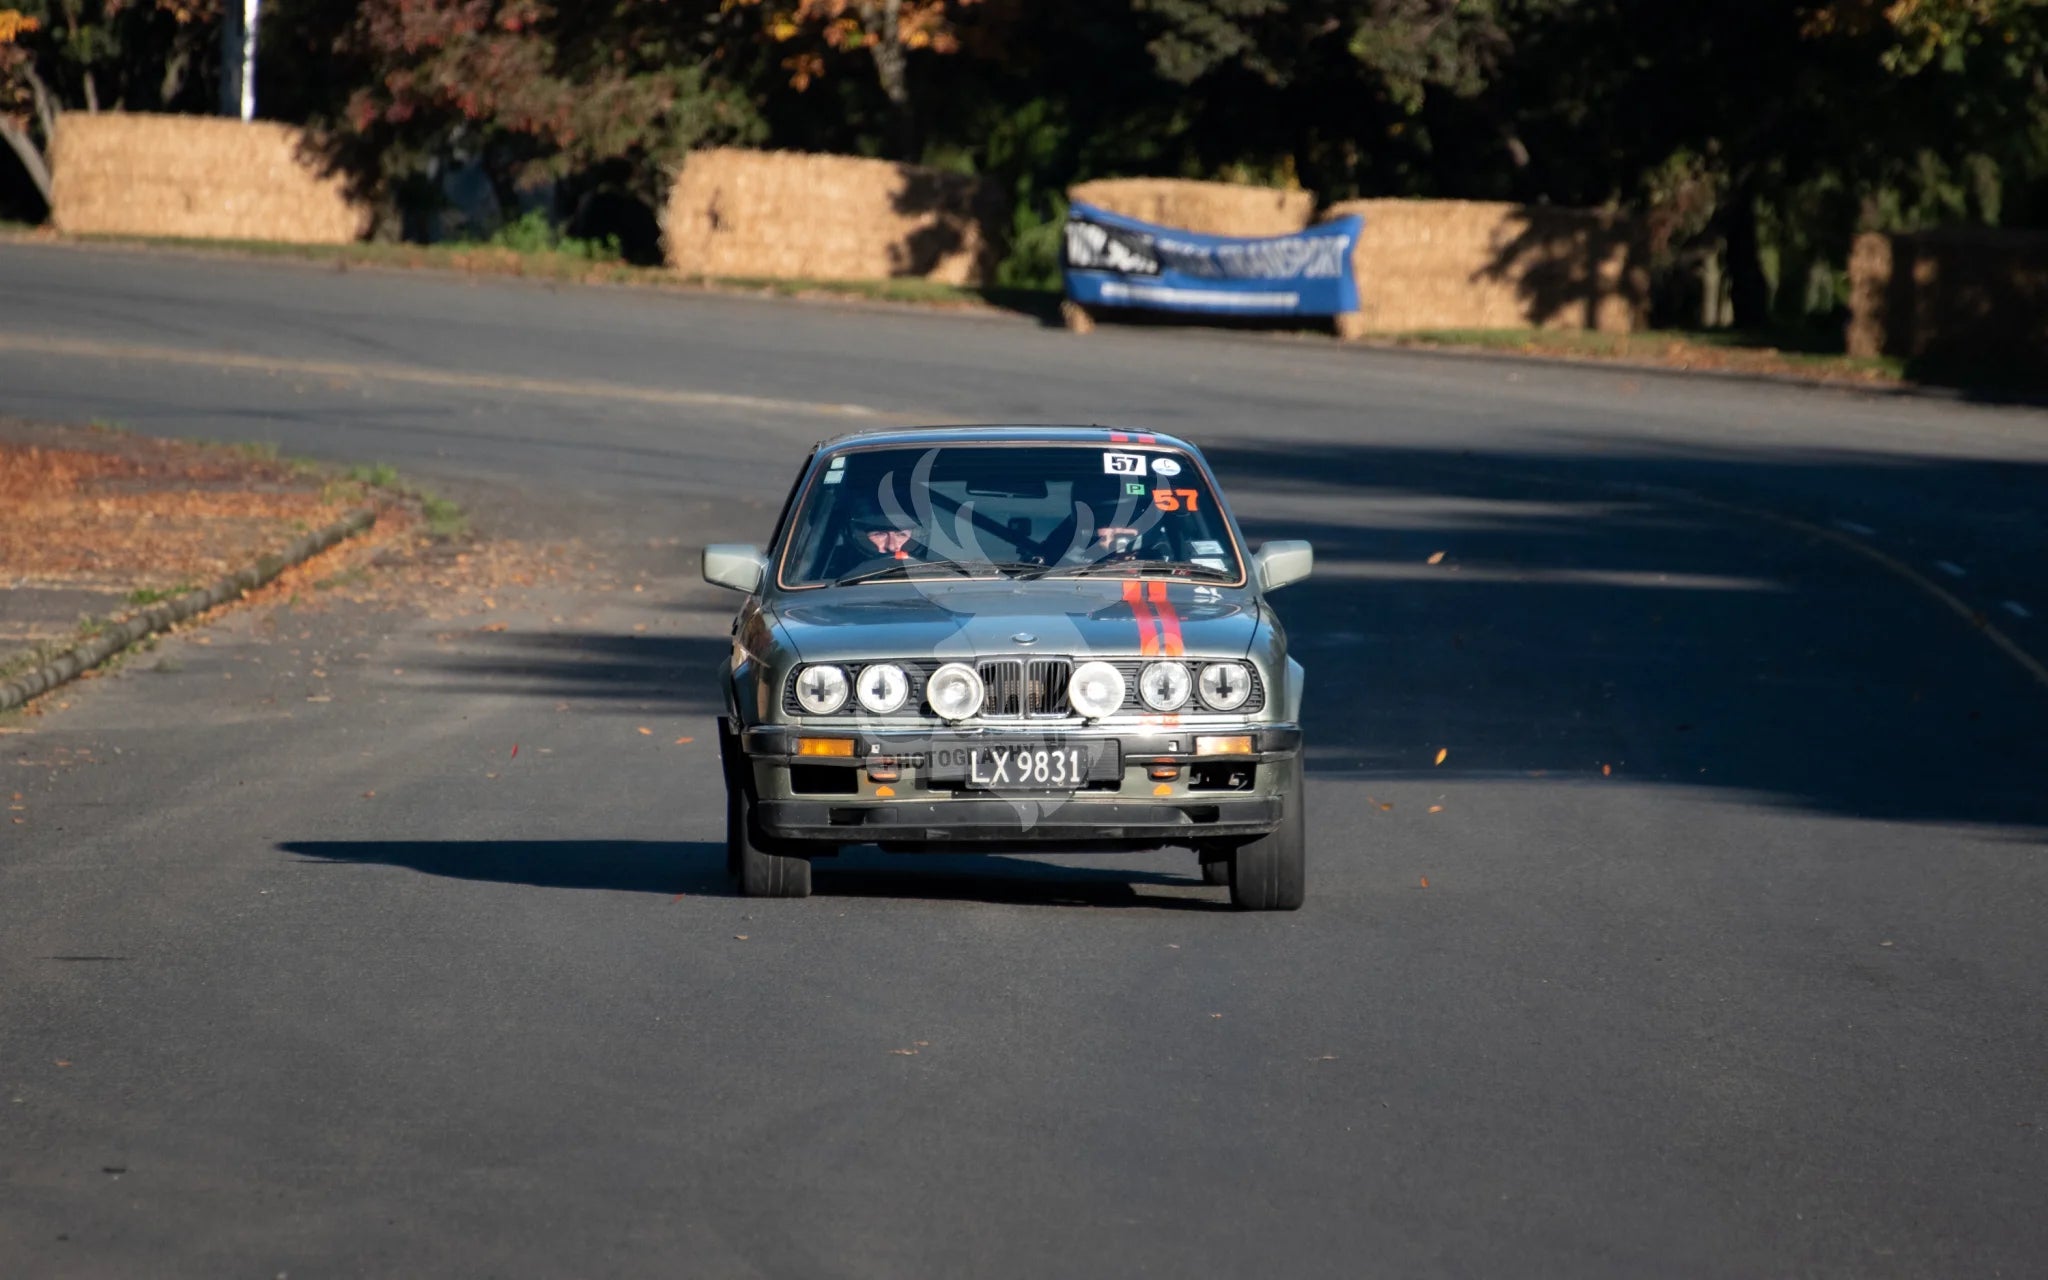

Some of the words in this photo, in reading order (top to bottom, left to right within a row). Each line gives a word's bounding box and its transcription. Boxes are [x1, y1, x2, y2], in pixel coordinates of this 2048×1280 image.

[1111, 455, 1139, 473] 57
[1130, 485, 1141, 493] P
[1152, 489, 1199, 512] 57
[970, 750, 1010, 783] LX
[1017, 750, 1080, 783] 9831
